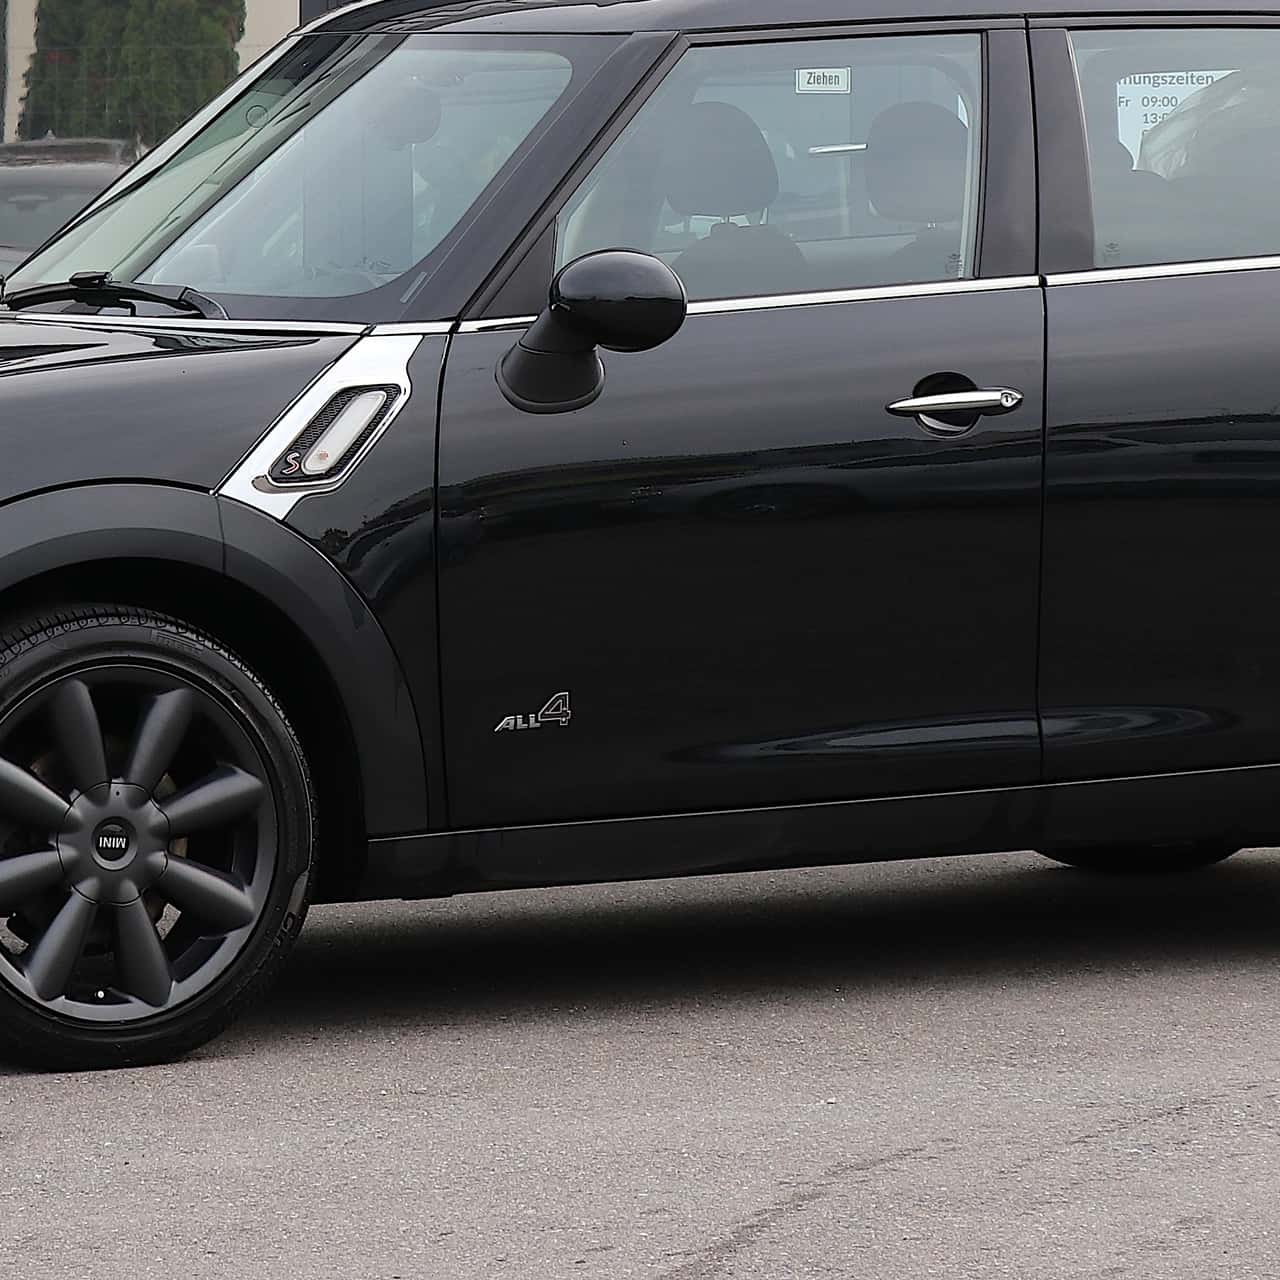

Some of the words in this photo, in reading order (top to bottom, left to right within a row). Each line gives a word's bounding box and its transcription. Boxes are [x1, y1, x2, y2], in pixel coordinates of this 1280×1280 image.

[806, 71, 840, 86] Ziehen
[1119, 71, 1215, 88] nungszeiten
[1118, 95, 1132, 107] Fr
[1141, 95, 1179, 108] 09:00
[99, 836, 127, 849] MINI
